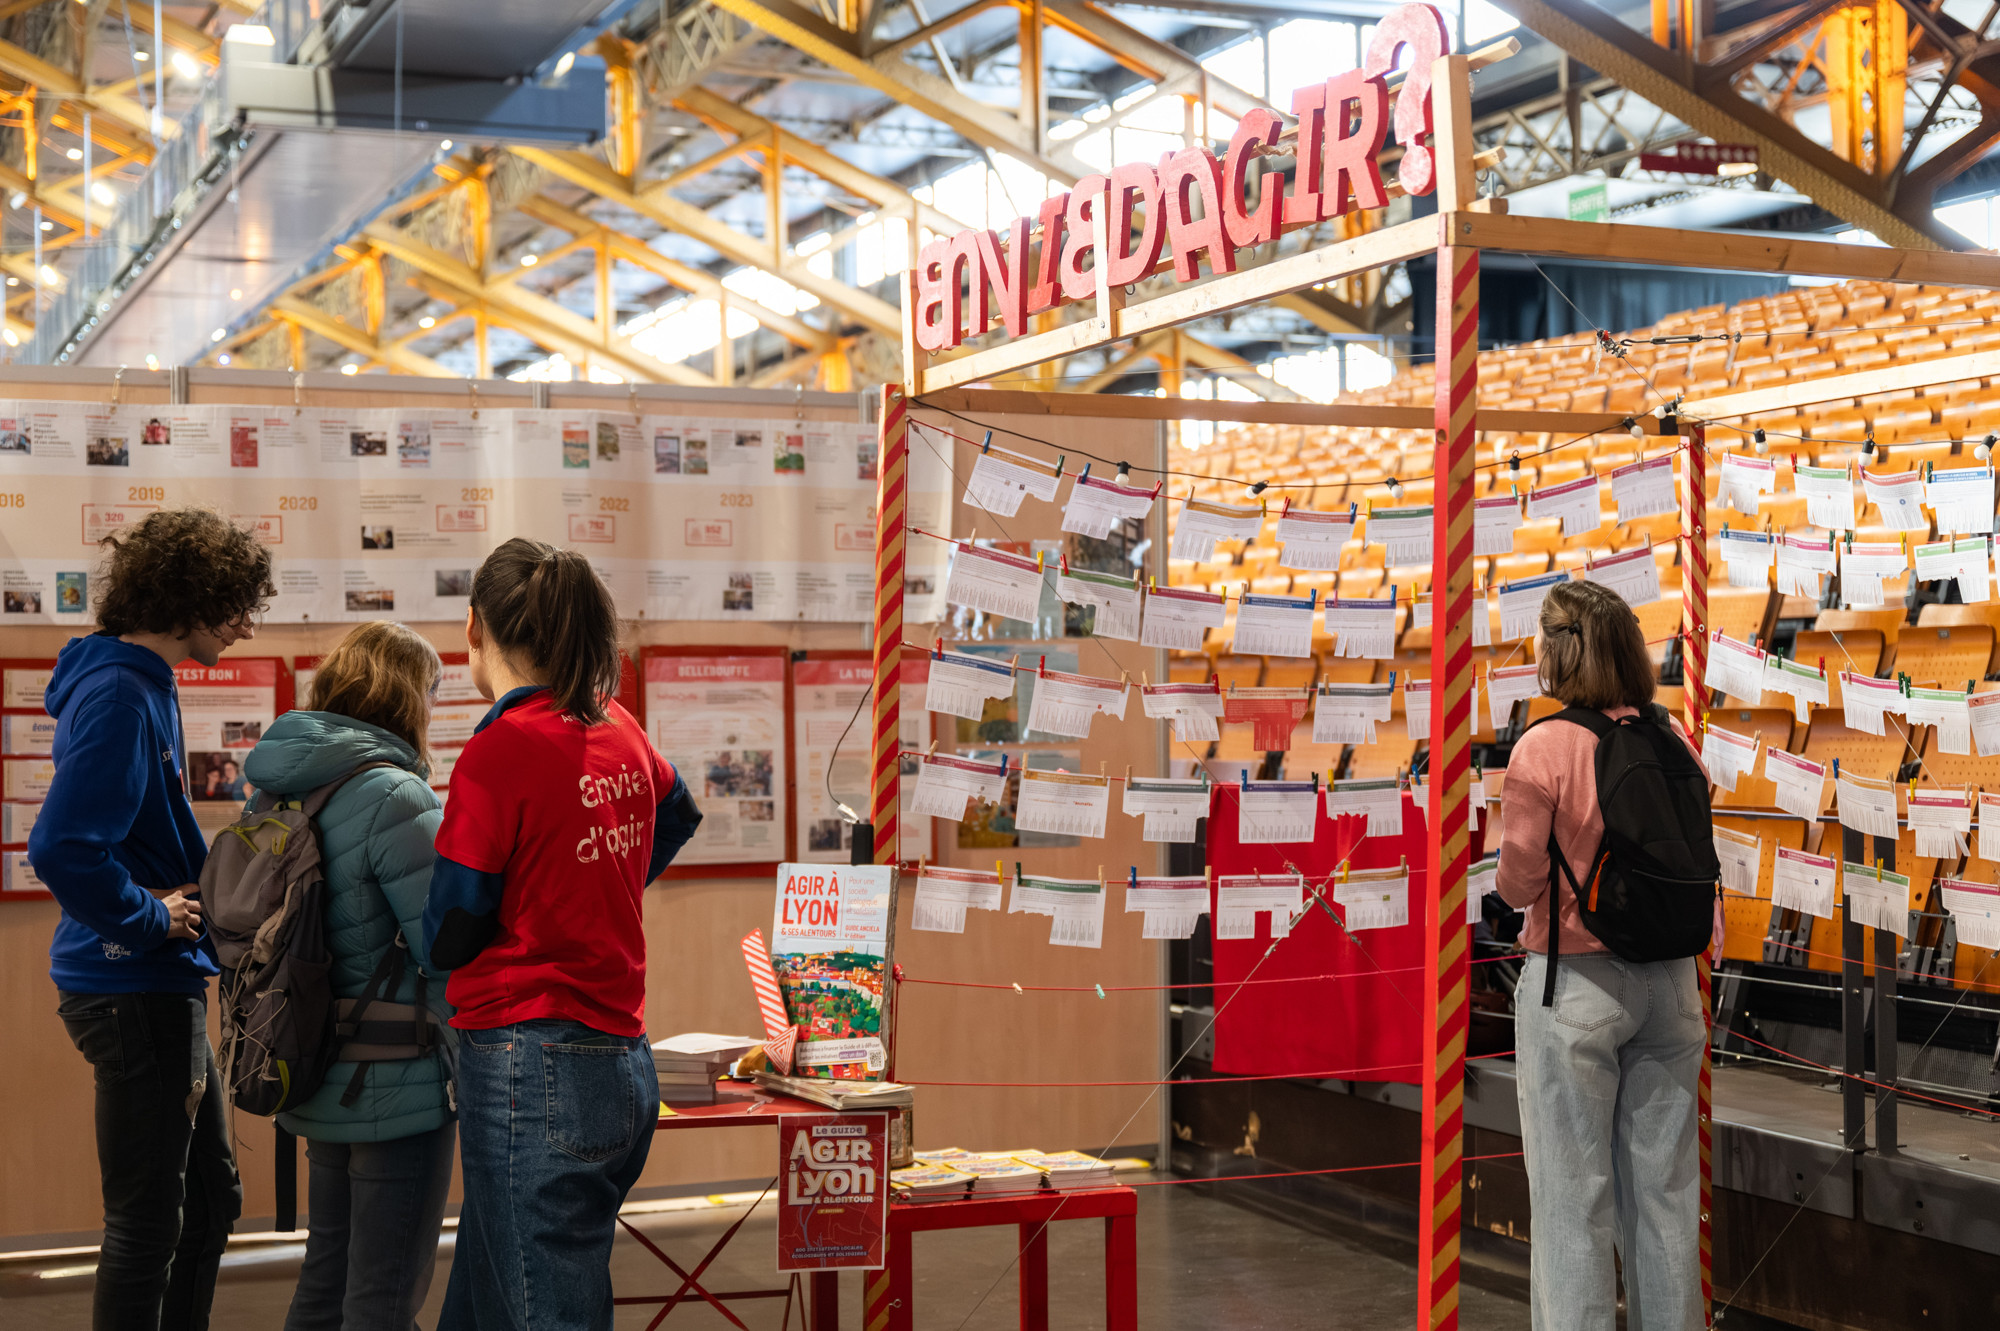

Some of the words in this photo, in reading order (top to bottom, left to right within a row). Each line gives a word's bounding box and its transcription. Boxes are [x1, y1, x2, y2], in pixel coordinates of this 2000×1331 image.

[128, 486, 165, 501] 2019
[461, 488, 494, 502] 2021
[720, 493, 753, 508] 2023
[278, 496, 318, 511] 2020
[599, 496, 630, 512] 2022
[104, 512, 125, 522] 320
[208, 668, 234, 681] BON
[236, 668, 241, 681] !
[839, 668, 853, 680] LA
[576, 813, 645, 863] d'agir
[784, 874, 825, 896] AGIR
[827, 870, 840, 897] À
[848, 876, 862, 886] Pour
[863, 878, 875, 886] une
[782, 898, 839, 926] LYON
[780, 928, 786, 936] &
[787, 928, 799, 936] SES
[799, 928, 837, 938] ALENTOURS
[789, 1130, 874, 1162] AGIR
